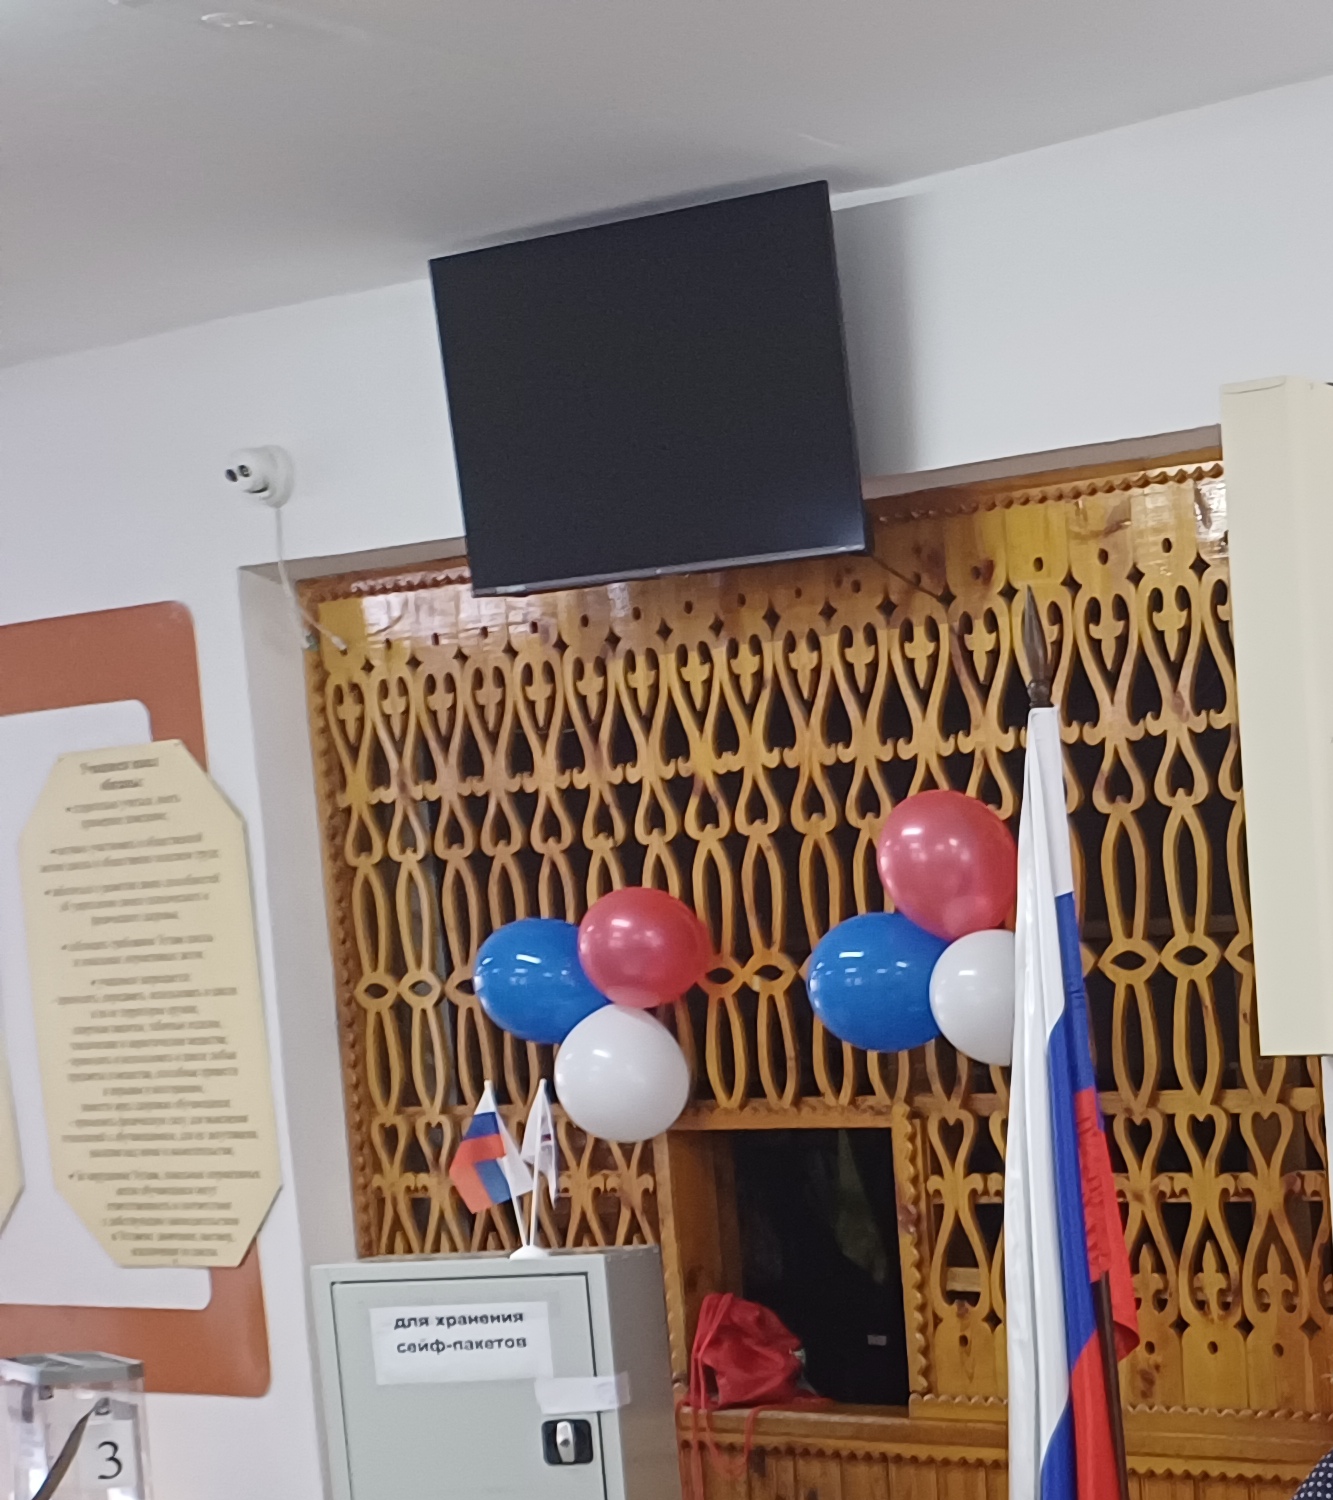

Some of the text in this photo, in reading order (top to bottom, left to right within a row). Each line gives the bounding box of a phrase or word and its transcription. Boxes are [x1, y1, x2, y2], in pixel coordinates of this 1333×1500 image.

[393, 1312, 525, 1330] для хранения
[396, 1336, 528, 1355] сейф-пакетов
[97, 1440, 123, 1480] 3
